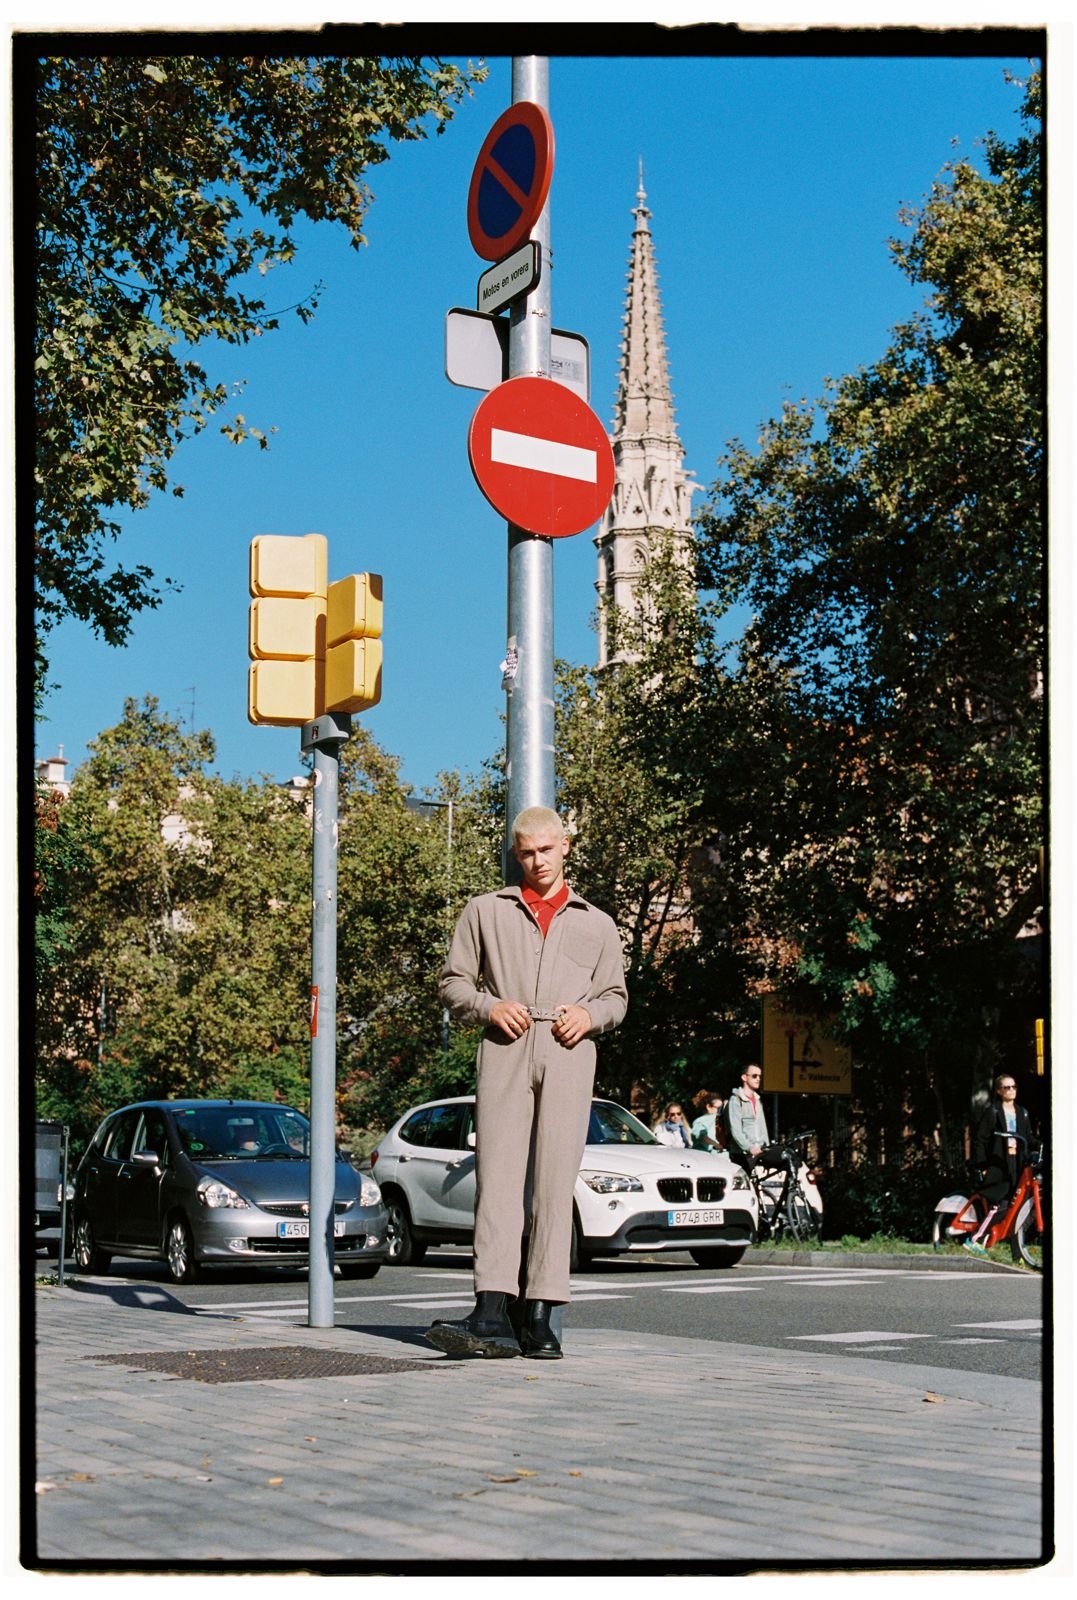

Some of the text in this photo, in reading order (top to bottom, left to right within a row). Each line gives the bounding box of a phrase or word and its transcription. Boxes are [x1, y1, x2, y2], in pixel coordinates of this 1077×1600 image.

[483, 262, 529, 300] Motos en vorera
[703, 1211, 721, 1222] GRR
[287, 1224, 308, 1235] 450
